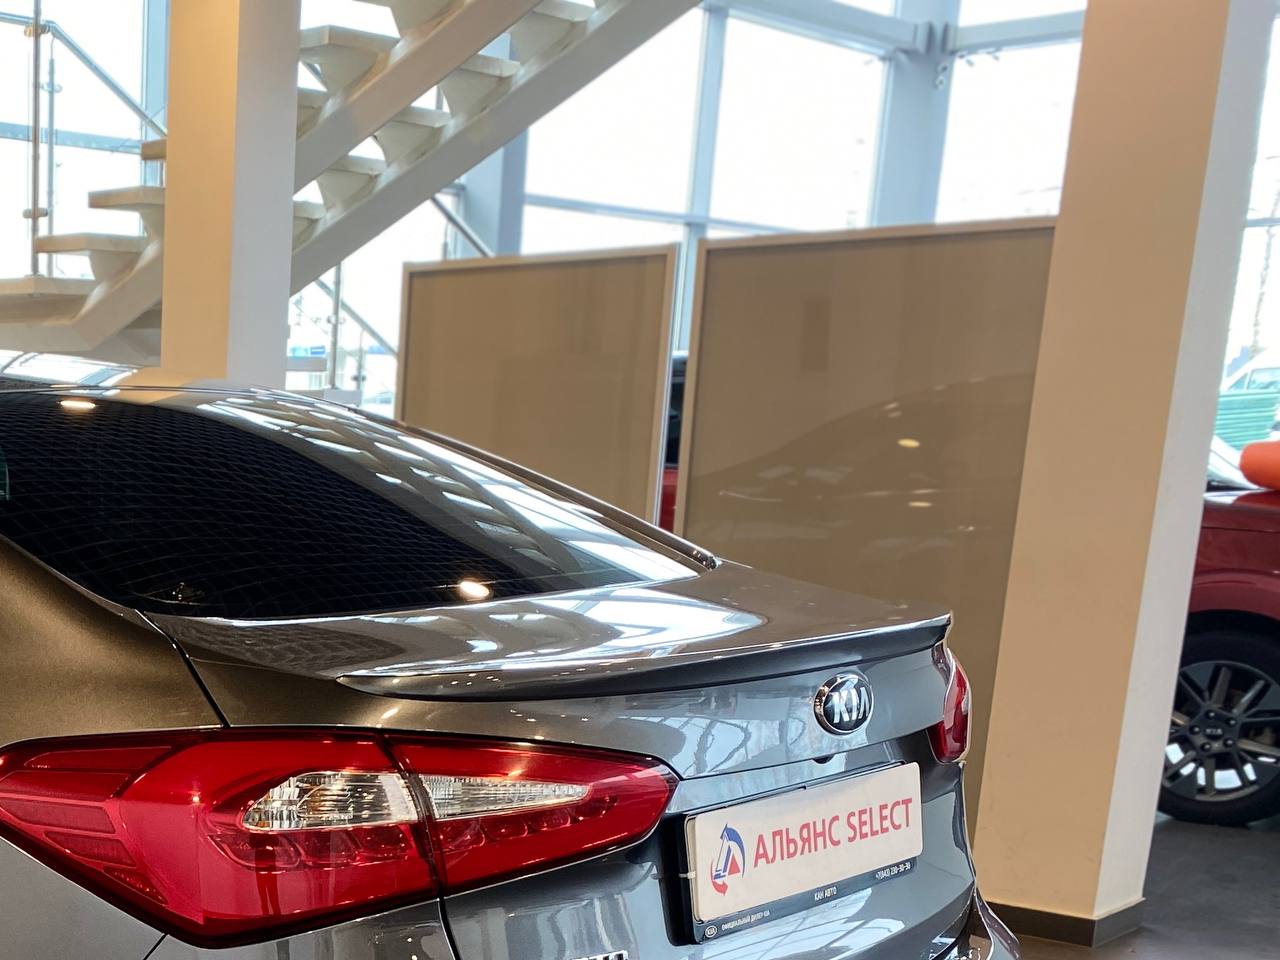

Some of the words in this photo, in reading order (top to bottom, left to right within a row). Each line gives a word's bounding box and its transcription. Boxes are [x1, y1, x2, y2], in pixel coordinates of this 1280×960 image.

[829, 686, 870, 724] KIA
[753, 814, 842, 868] АЛЬЯНС
[846, 797, 914, 844] SELECT
